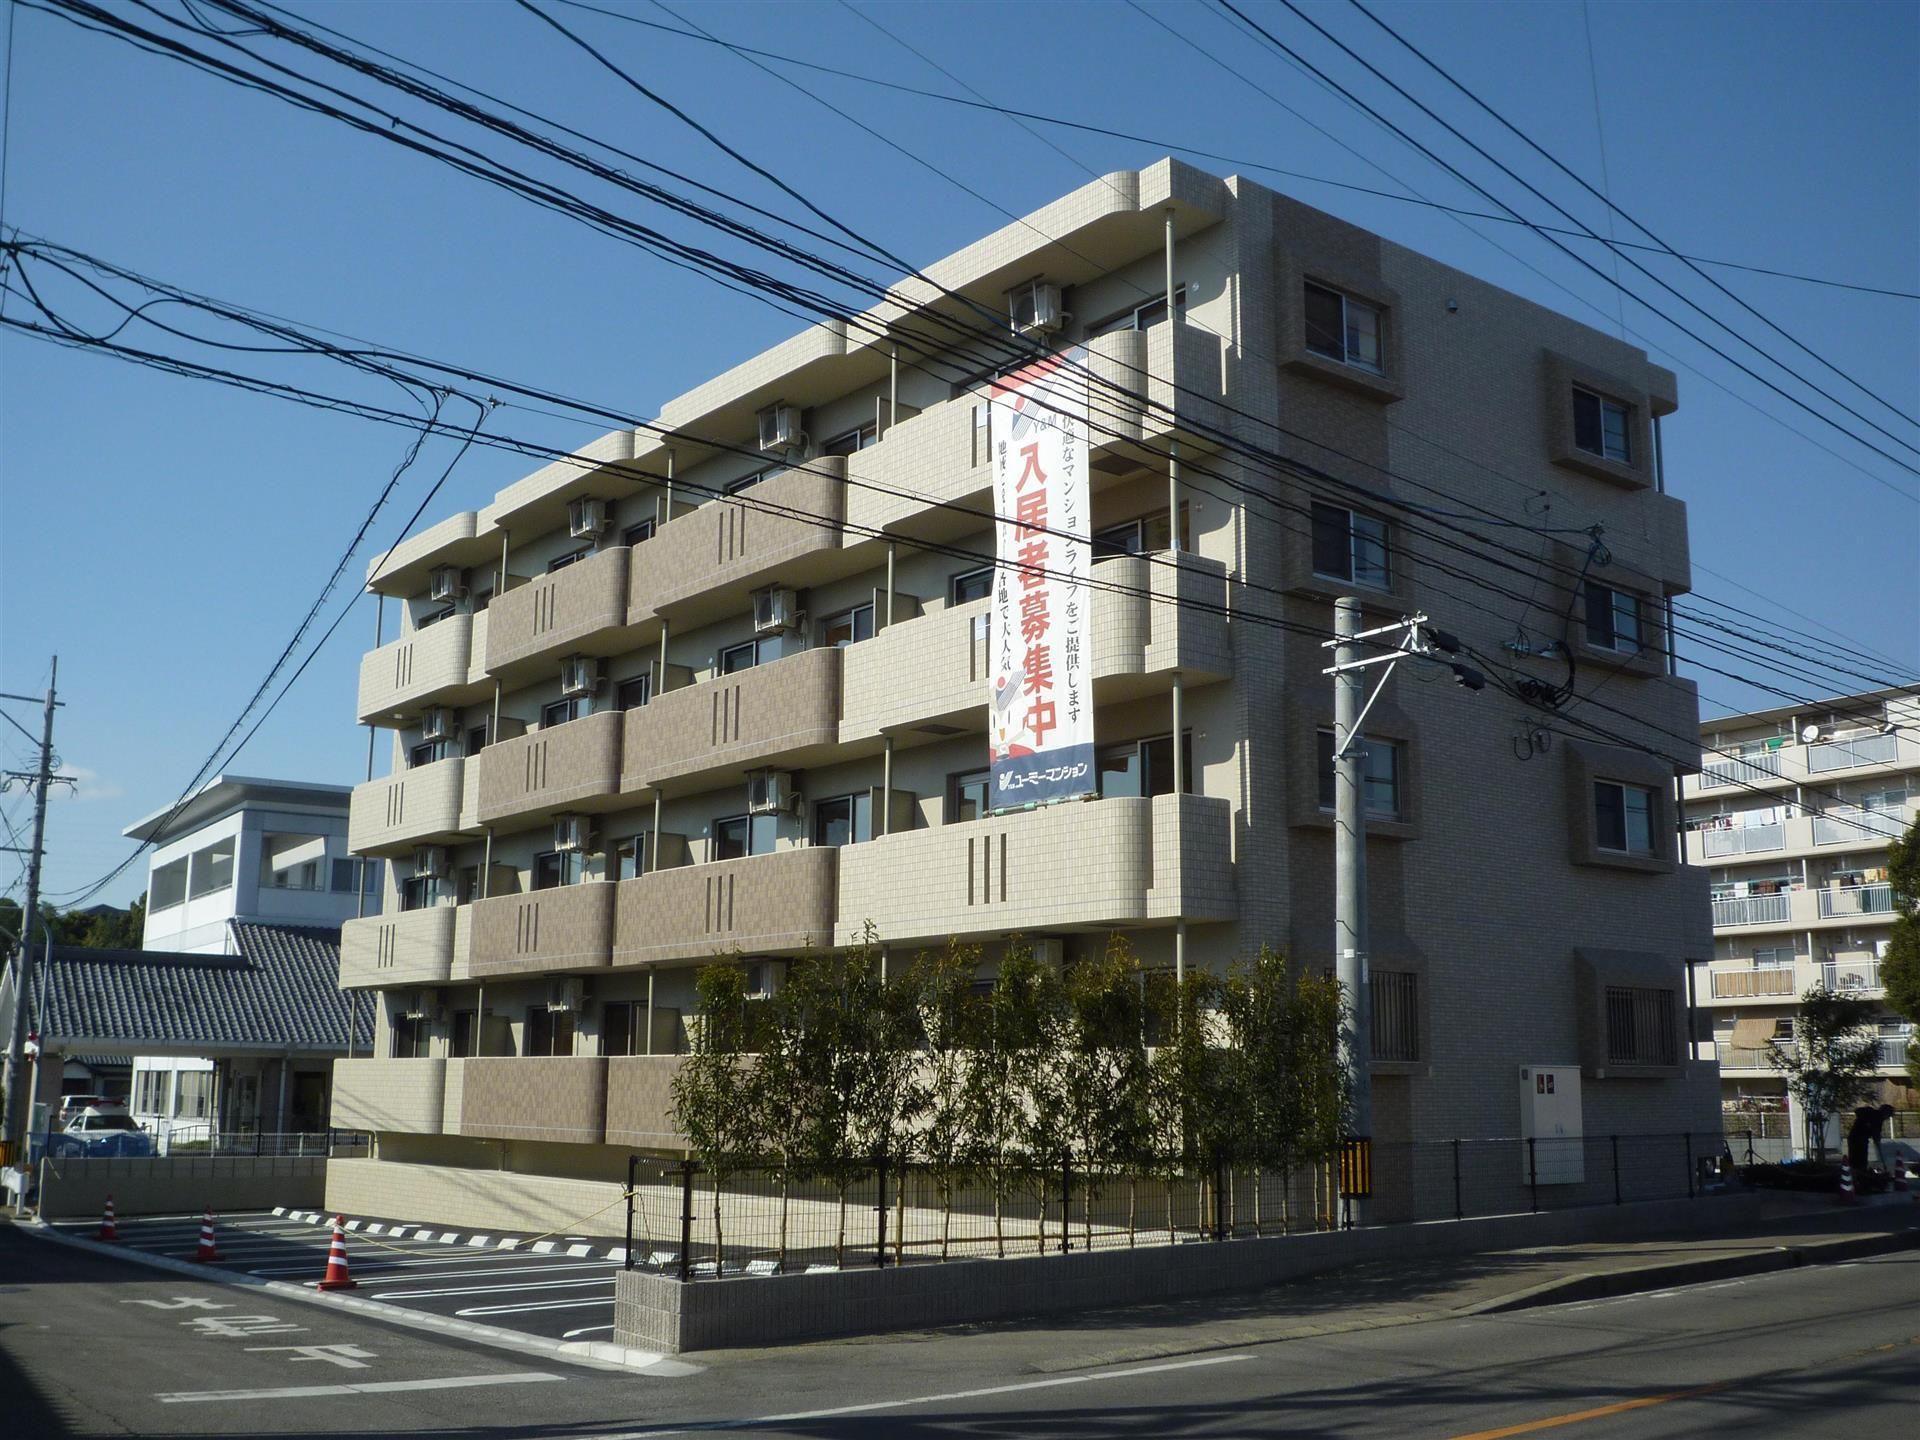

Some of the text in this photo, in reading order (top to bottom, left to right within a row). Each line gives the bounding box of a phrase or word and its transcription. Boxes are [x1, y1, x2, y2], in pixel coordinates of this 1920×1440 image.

[1014, 441, 1057, 748] 入居者募集中
[1014, 763, 1088, 789] ユーミーマンション
